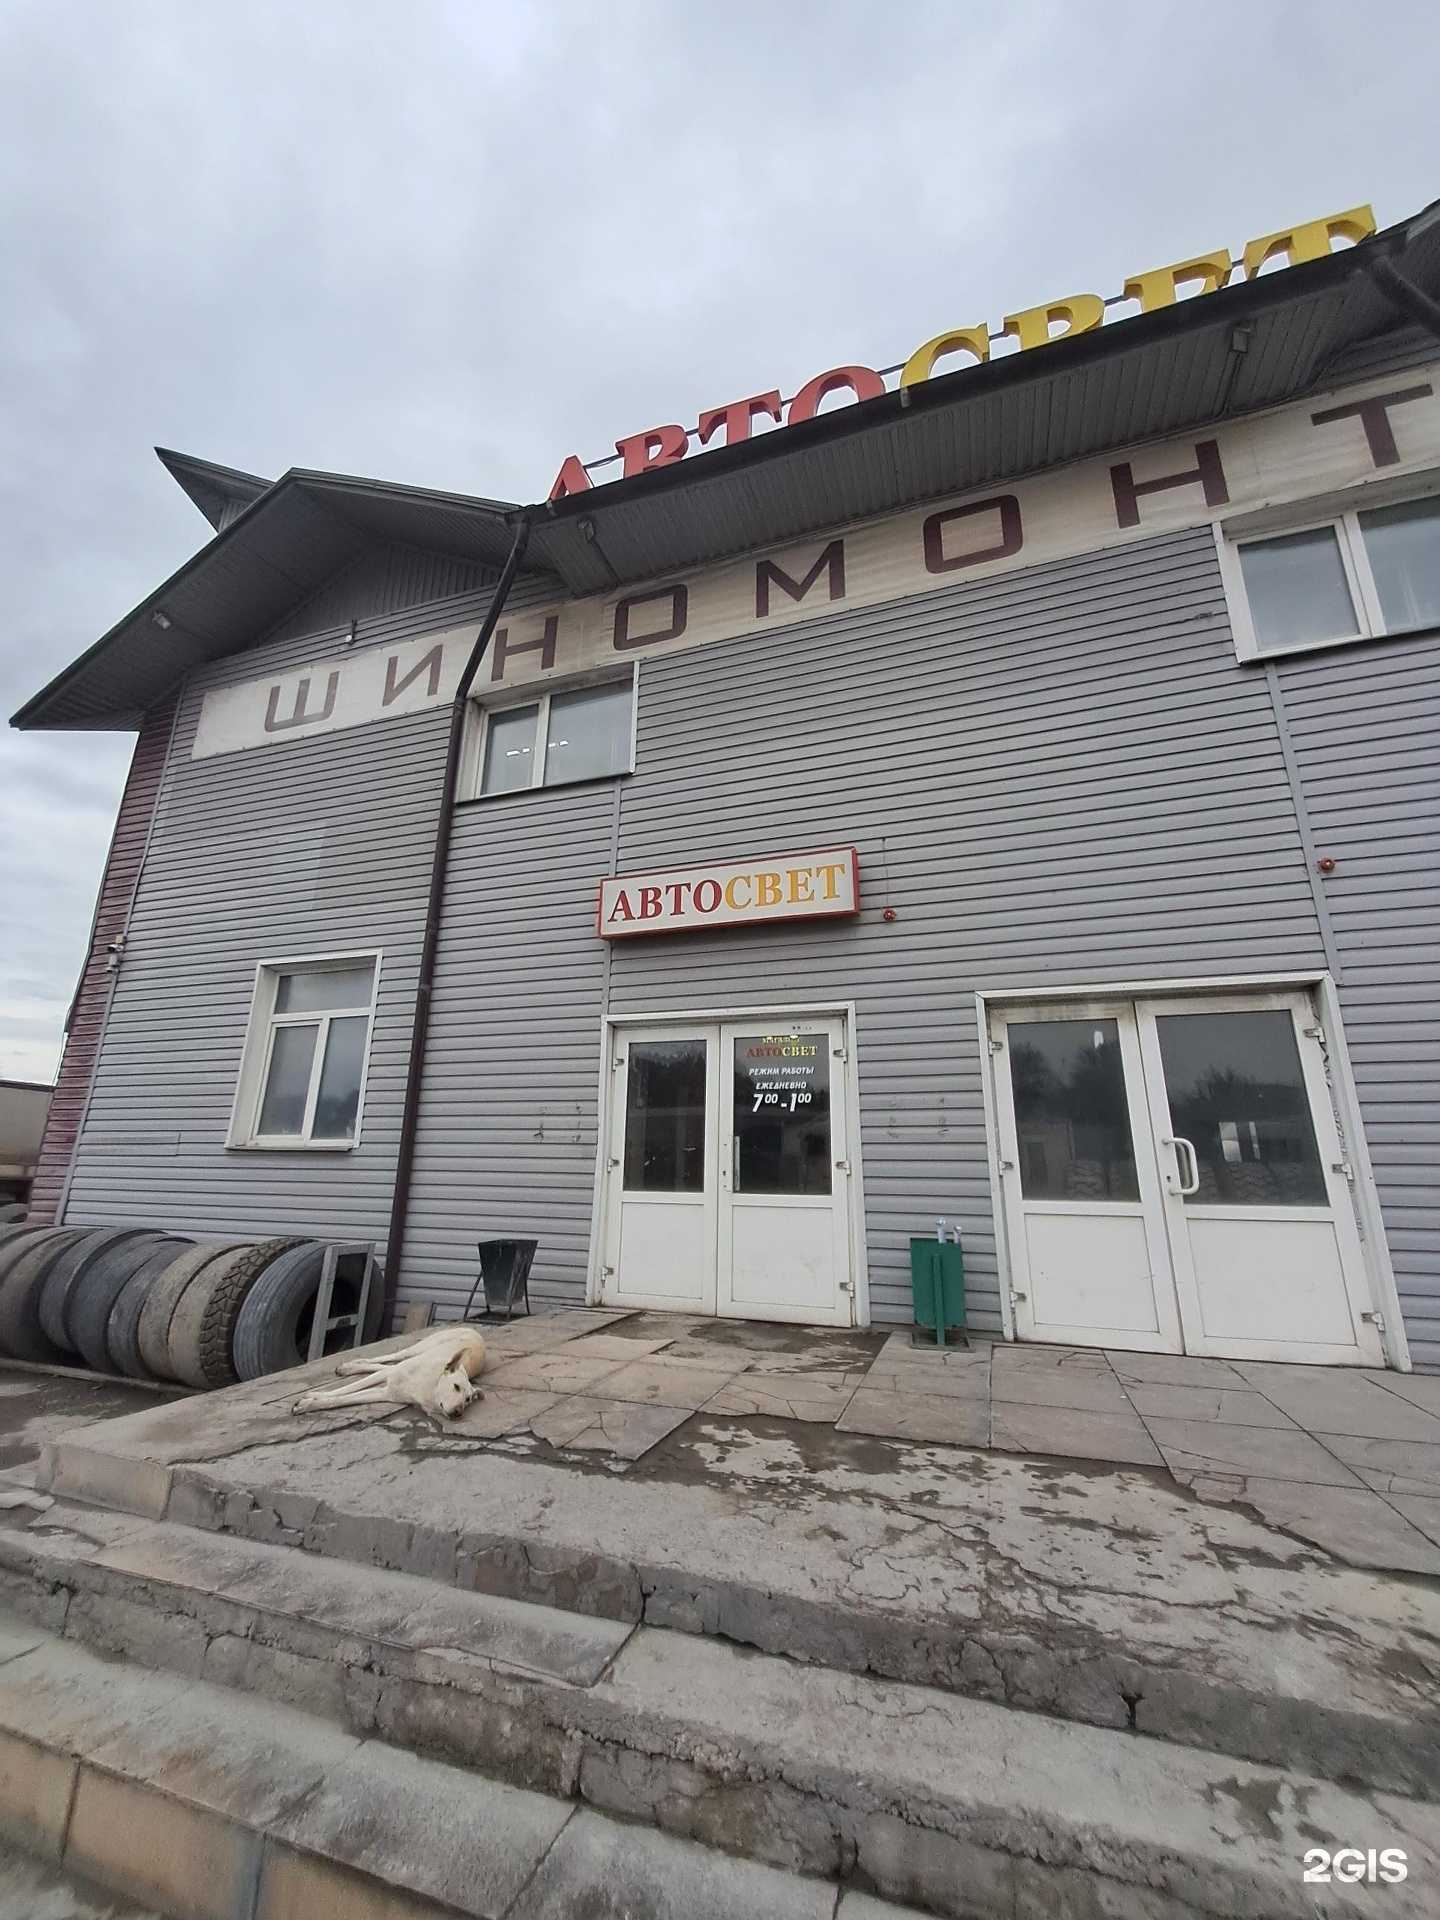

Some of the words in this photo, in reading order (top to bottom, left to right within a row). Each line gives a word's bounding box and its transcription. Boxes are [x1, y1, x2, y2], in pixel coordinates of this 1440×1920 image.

[264, 383, 1434, 733] ШИНОМОНТ
[607, 863, 846, 923] АВТОСВЕТ
[746, 1046, 817, 1056] АВТОСВЕТ
[748, 1068, 780, 1076] РЕЖИМ
[781, 1066, 815, 1075] РАБОТЫ
[755, 1081, 807, 1090] ЕЖЕДНЕВНО
